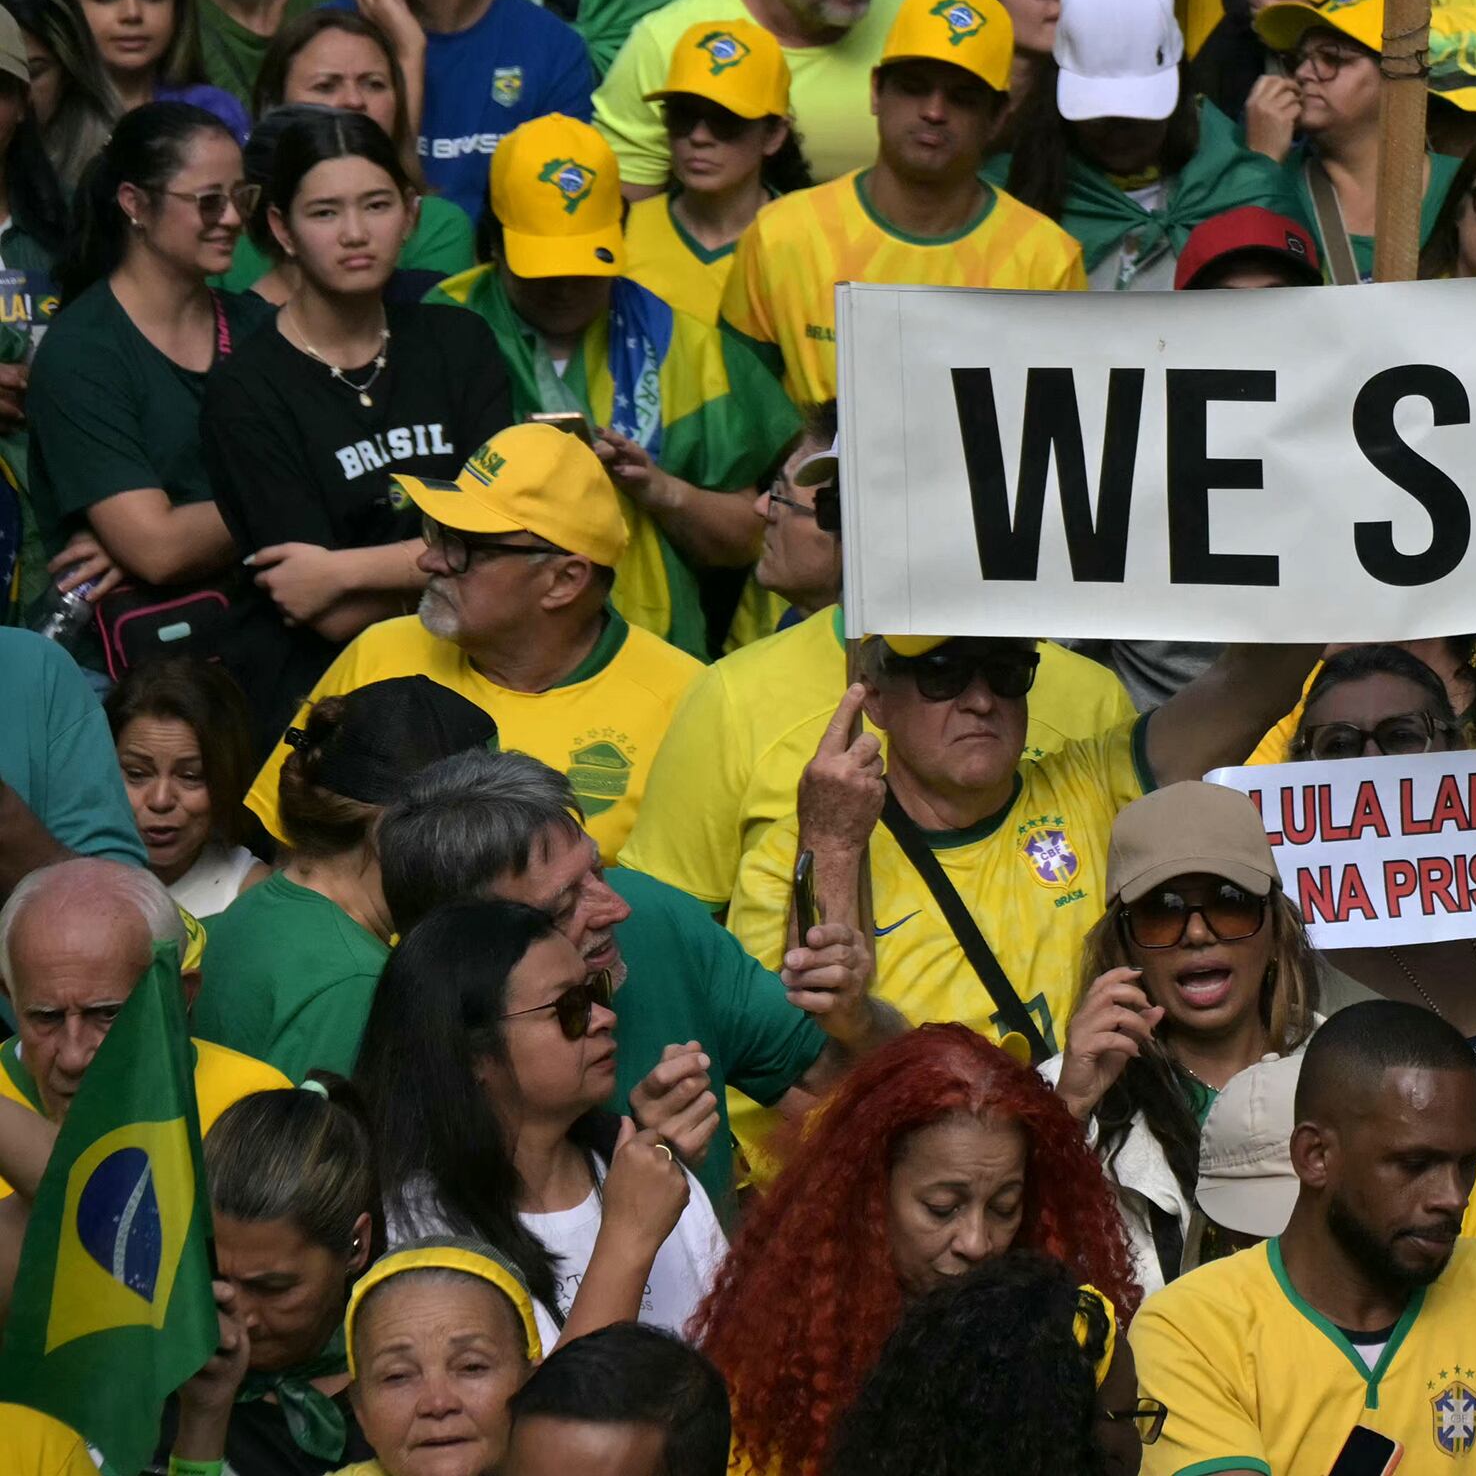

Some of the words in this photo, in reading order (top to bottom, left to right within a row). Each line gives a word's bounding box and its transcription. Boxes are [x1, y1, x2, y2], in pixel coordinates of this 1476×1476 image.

[950, 367, 1282, 588] WE
[1250, 779, 1388, 849] LULA
[1040, 845, 1063, 862] CBF
[1296, 858, 1378, 926] NA
